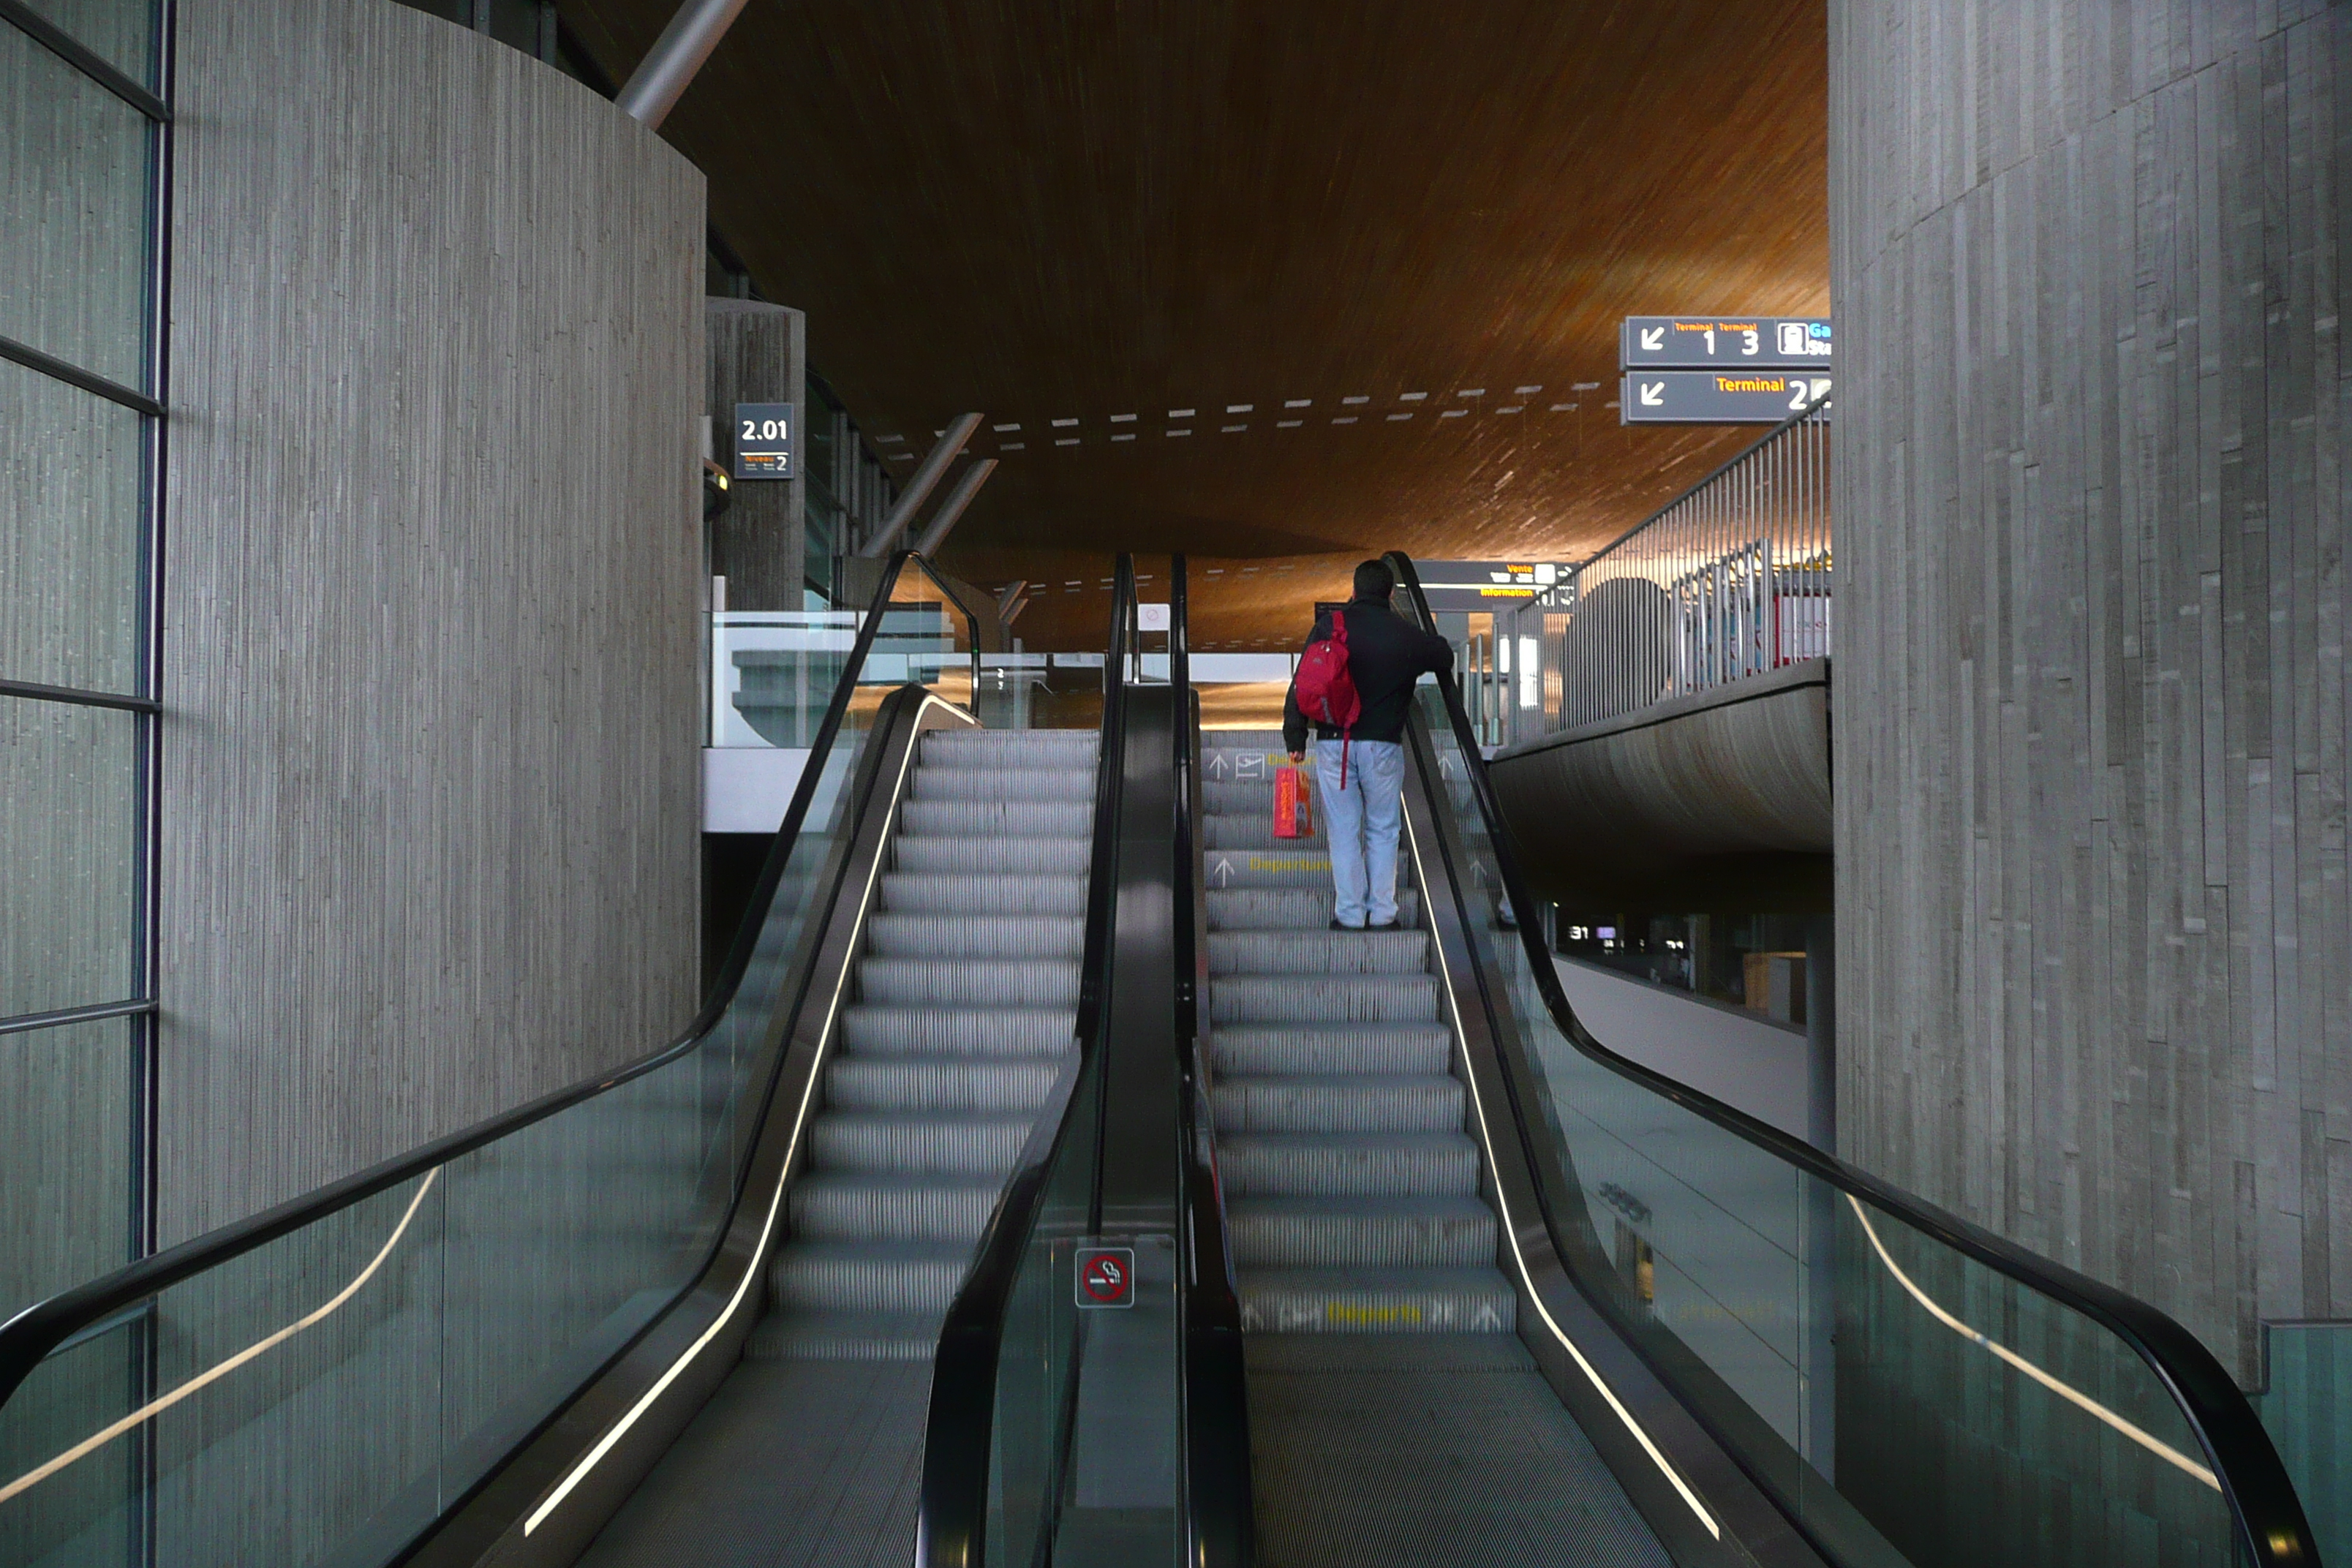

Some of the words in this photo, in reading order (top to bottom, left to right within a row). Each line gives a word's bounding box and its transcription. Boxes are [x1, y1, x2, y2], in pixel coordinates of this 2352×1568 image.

[1675, 323, 1713, 331] Terminal
[1719, 323, 1757, 331] Terminal
[1703, 331, 1715, 355] 1
[1741, 331, 1759, 355] 3
[1716, 377, 1784, 392] Terminal
[1788, 380, 1808, 410] 2
[742, 420, 787, 440] 2.01
[777, 456, 787, 470] 2
[1507, 564, 1533, 573] Vente
[1480, 589, 1533, 598] Information
